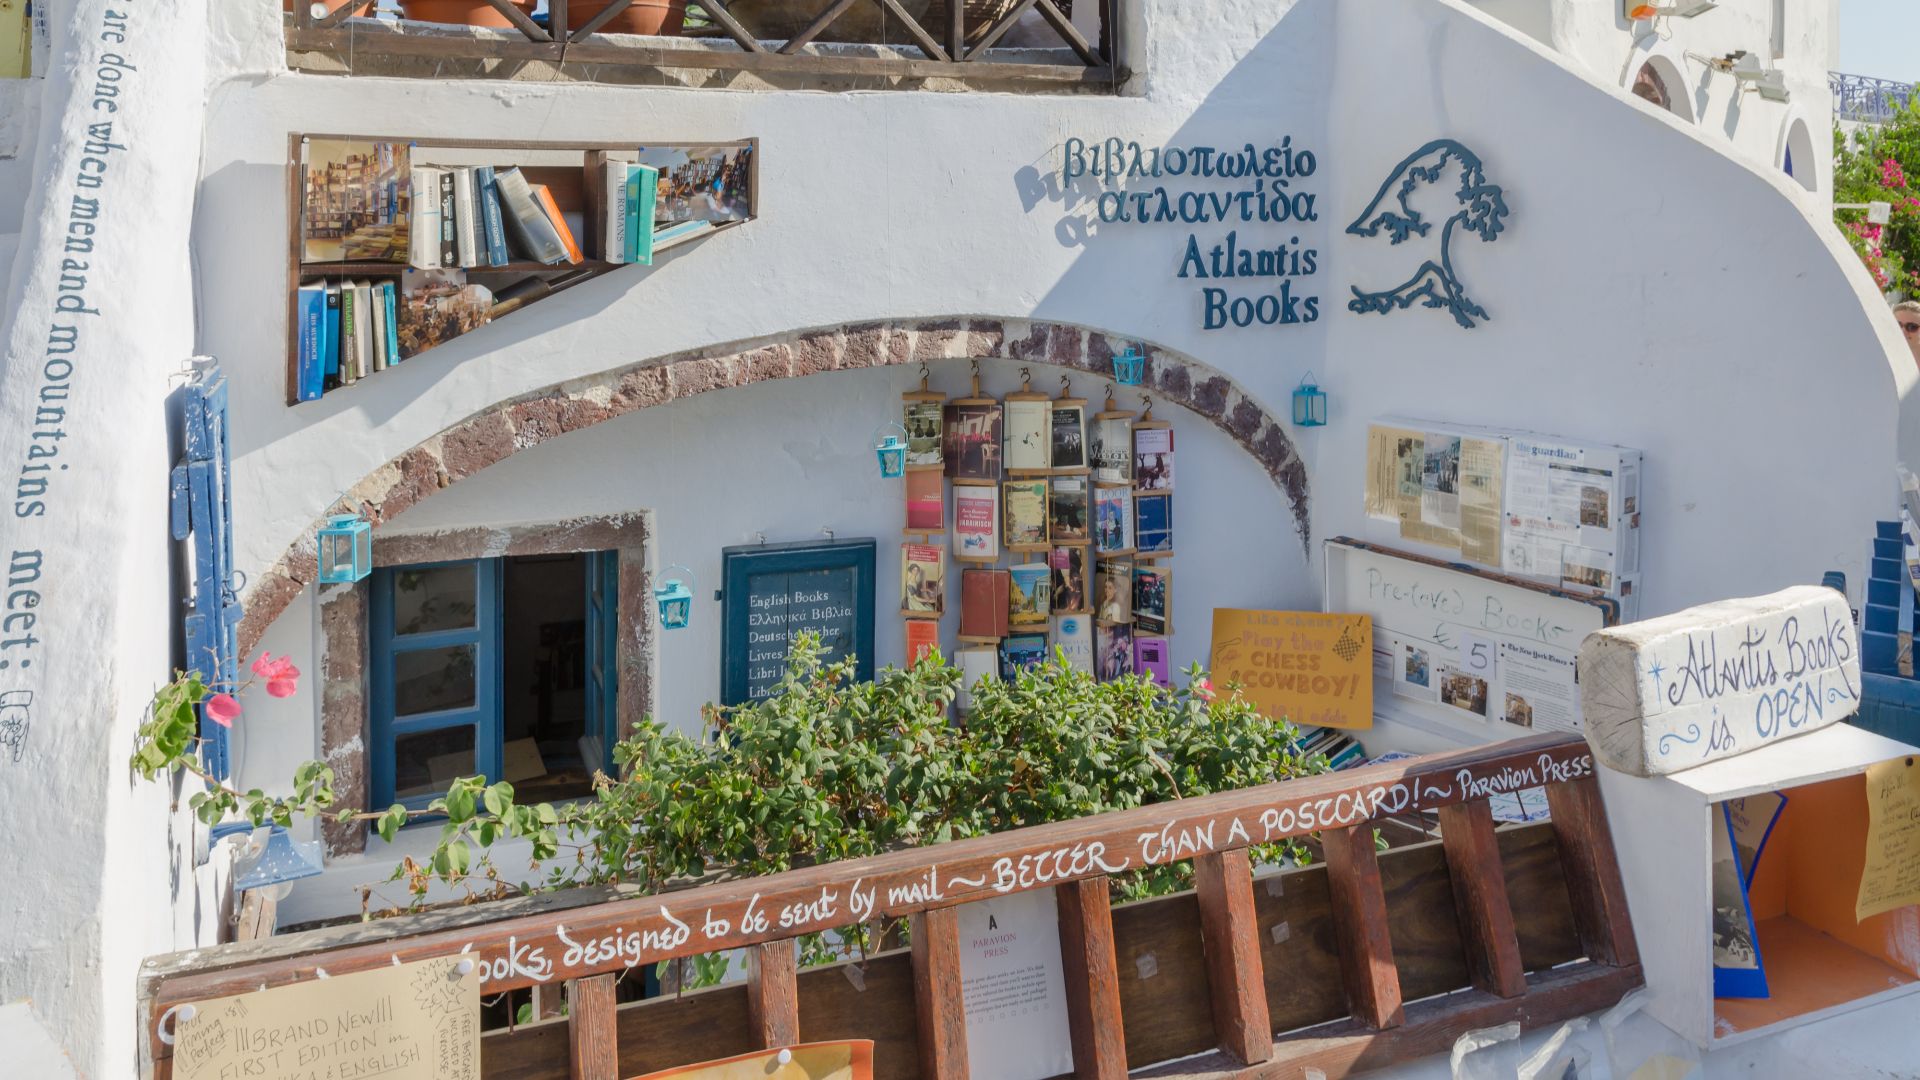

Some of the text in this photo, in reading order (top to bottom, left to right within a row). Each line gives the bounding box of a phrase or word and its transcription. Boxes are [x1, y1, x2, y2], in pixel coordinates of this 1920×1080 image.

[101, 9, 128, 44] are
[92, 53, 137, 113] done
[77, 121, 128, 189] when
[1064, 135, 1317, 188] βιβλιοπωλείο
[616, 197, 626, 243] ROMANS
[1098, 179, 1318, 223] ατλαντίδα
[64, 194, 100, 253] men
[1177, 230, 1317, 278] Atlantis
[55, 258, 101, 316] and
[1202, 279, 1319, 329] Books
[14, 323, 79, 519] mountains
[749, 605, 852, 626] Ελληνικά Βιβλία
[750, 591, 829, 609] English Books
[748, 665, 776, 680] Libri
[749, 650, 783, 662] Livres
[1250, 650, 1322, 671] CHESS
[1470, 643, 1488, 669] 5
[1507, 642, 1519, 652] The
[1520, 646, 1532, 656] New
[1532, 650, 1548, 661] York
[1548, 655, 1567, 666] Times
[1668, 623, 1779, 706] Atlantis
[1778, 606, 1859, 700] Books
[1242, 670, 1361, 700] COWBOY!
[1703, 674, 1823, 757] is OPEN
[467, 937, 554, 982] ooks,
[556, 904, 691, 969] designed
[702, 909, 730, 939] to
[741, 893, 770, 935] be
[779, 886, 838, 928] sent
[850, 878, 877, 922] by
[888, 865, 942, 905] mail
[992, 841, 1129, 893] BETTER
[1228, 816, 1251, 844] A
[1259, 777, 1420, 842] POSTCARD!
[972, 932, 1017, 949] PARAVION
[989, 914, 998, 931] A
[983, 946, 1010, 959] PRESS
[450, 1017, 460, 1066] INCLUDED
[461, 1013, 472, 1037] FREE
[220, 1050, 285, 1080] FIRST
[298, 1031, 378, 1066] EDITION
[340, 1044, 421, 1079] ENGLISH
